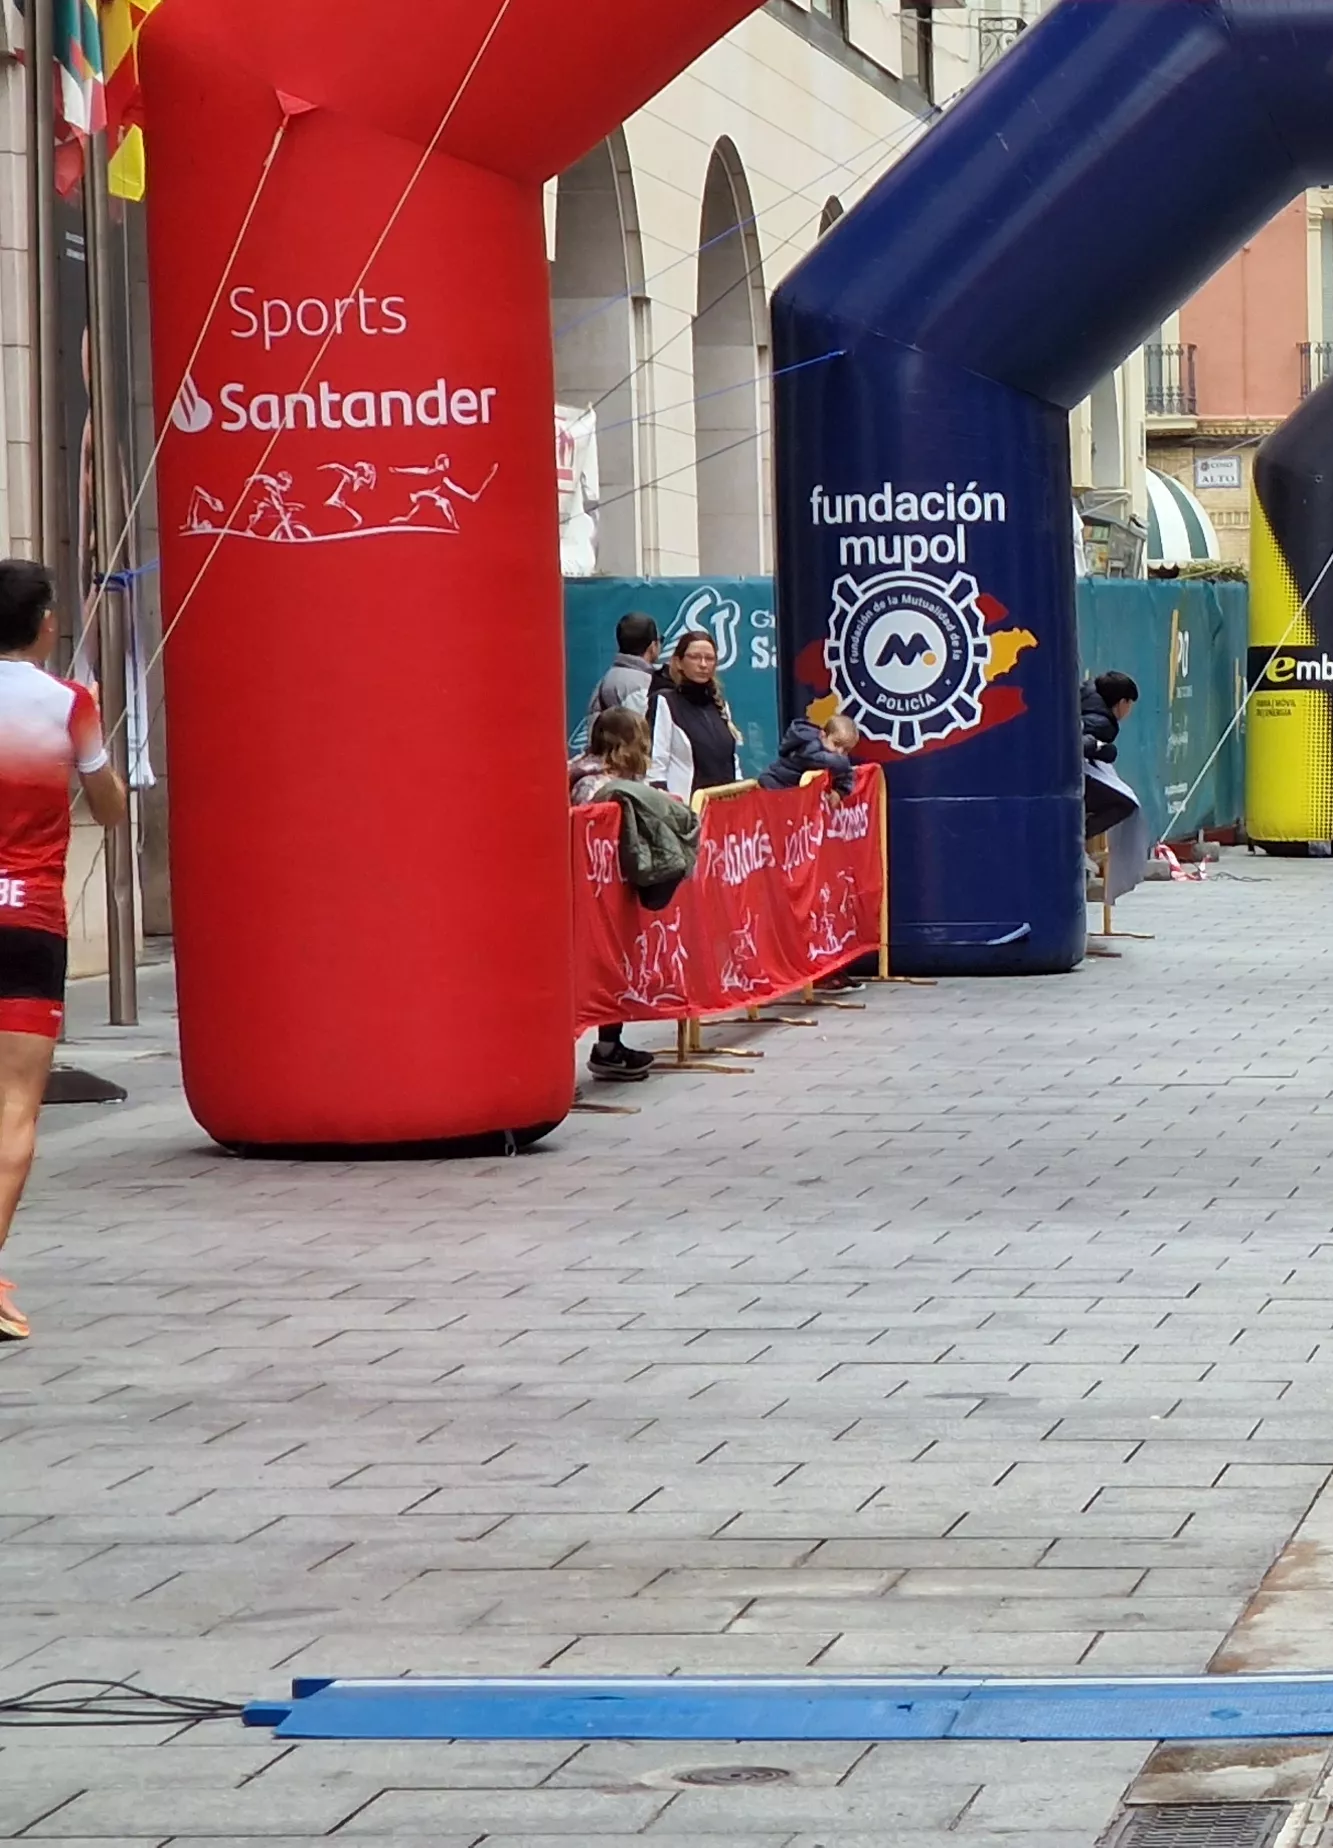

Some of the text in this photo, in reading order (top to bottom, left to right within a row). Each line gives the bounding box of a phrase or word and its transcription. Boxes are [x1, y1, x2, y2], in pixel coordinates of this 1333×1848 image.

[229, 286, 408, 350] Sports
[220, 378, 497, 432] Santander
[809, 480, 1007, 525] fundación
[1202, 475, 1236, 483] ALTO
[839, 523, 967, 573] mupol
[849, 592, 961, 665] Fundación de la Mutualidad de la
[875, 692, 938, 713] POLICÍA
